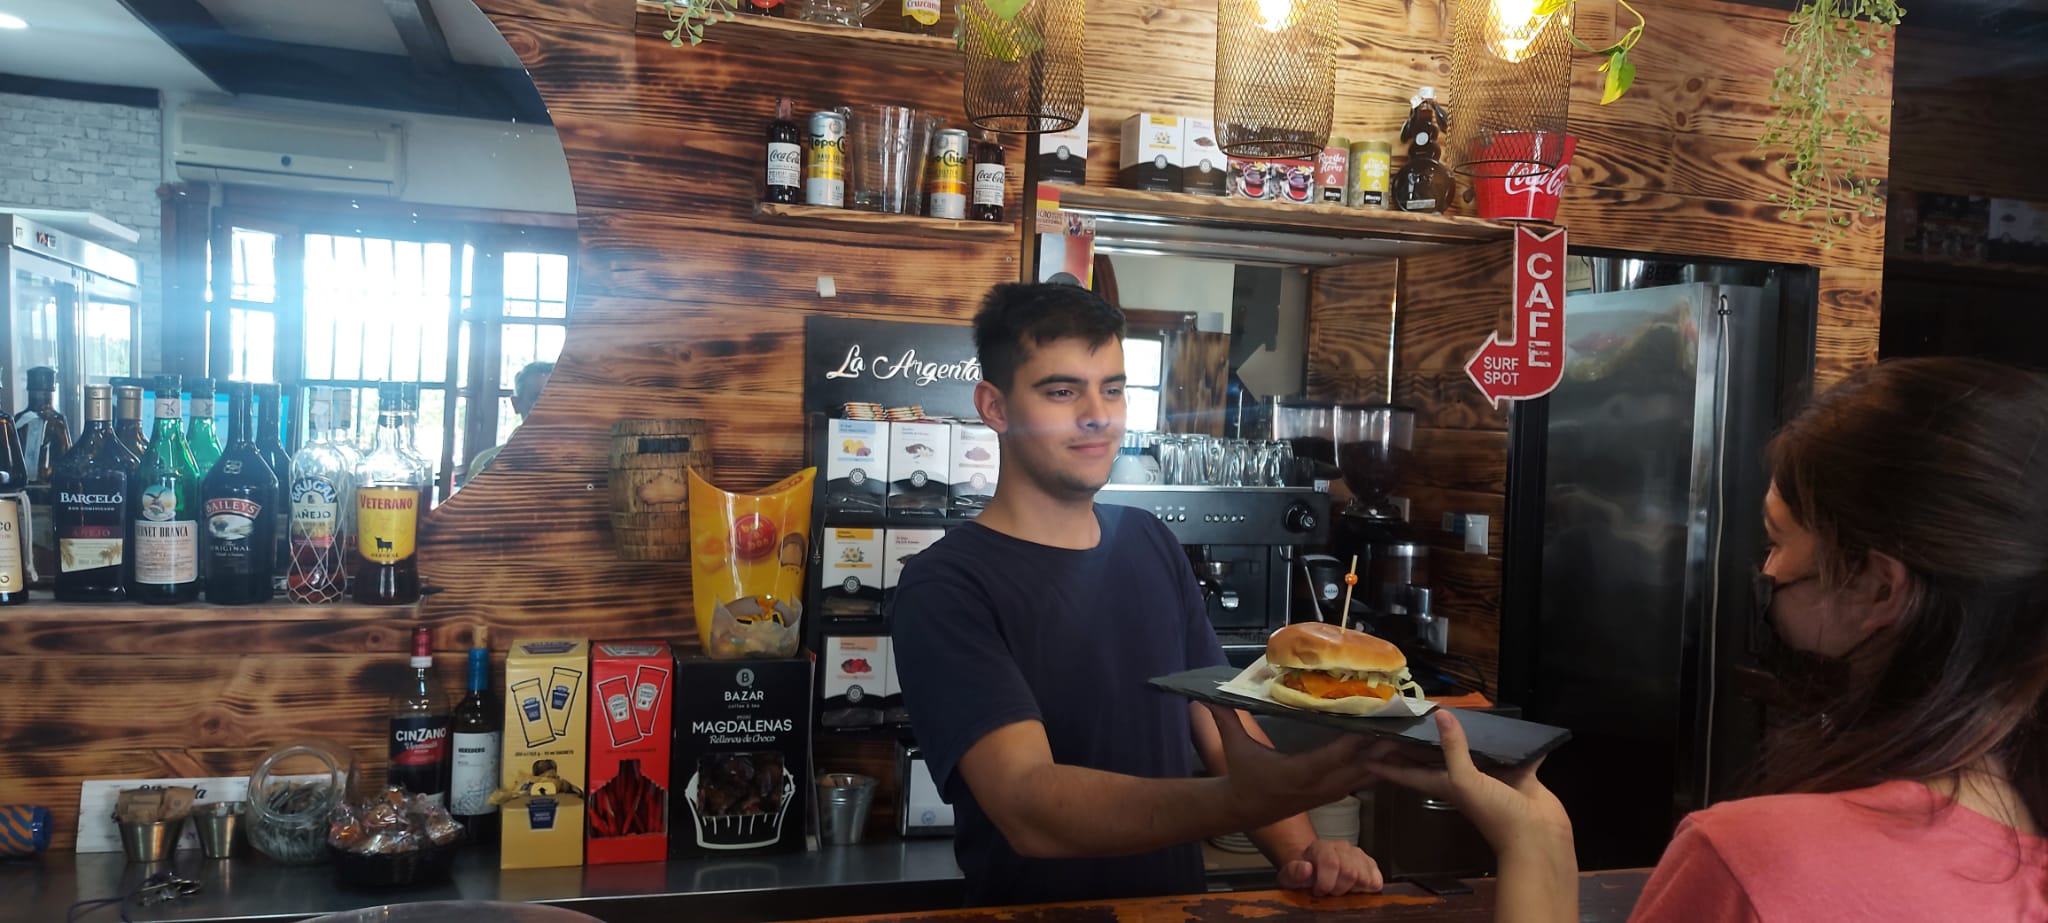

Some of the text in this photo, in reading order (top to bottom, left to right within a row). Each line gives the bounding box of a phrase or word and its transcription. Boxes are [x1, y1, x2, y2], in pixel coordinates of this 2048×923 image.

[1525, 253, 1553, 368] CAFE
[826, 344, 866, 380] La
[1484, 356, 1519, 371] SURF
[1484, 372, 1520, 386] SPOT
[60, 491, 123, 505] BARCELÓ
[292, 479, 337, 503] BRUGAL
[206, 500, 257, 514] BAILEYS
[360, 495, 413, 510] VETERANO
[295, 508, 331, 520] AÑEJO
[159, 526, 189, 538] BRANCA
[724, 690, 764, 701] BAZAR
[692, 719, 792, 734] MAGDALENAS
[395, 728, 446, 742] CINZANO
[752, 733, 776, 743] Choco
